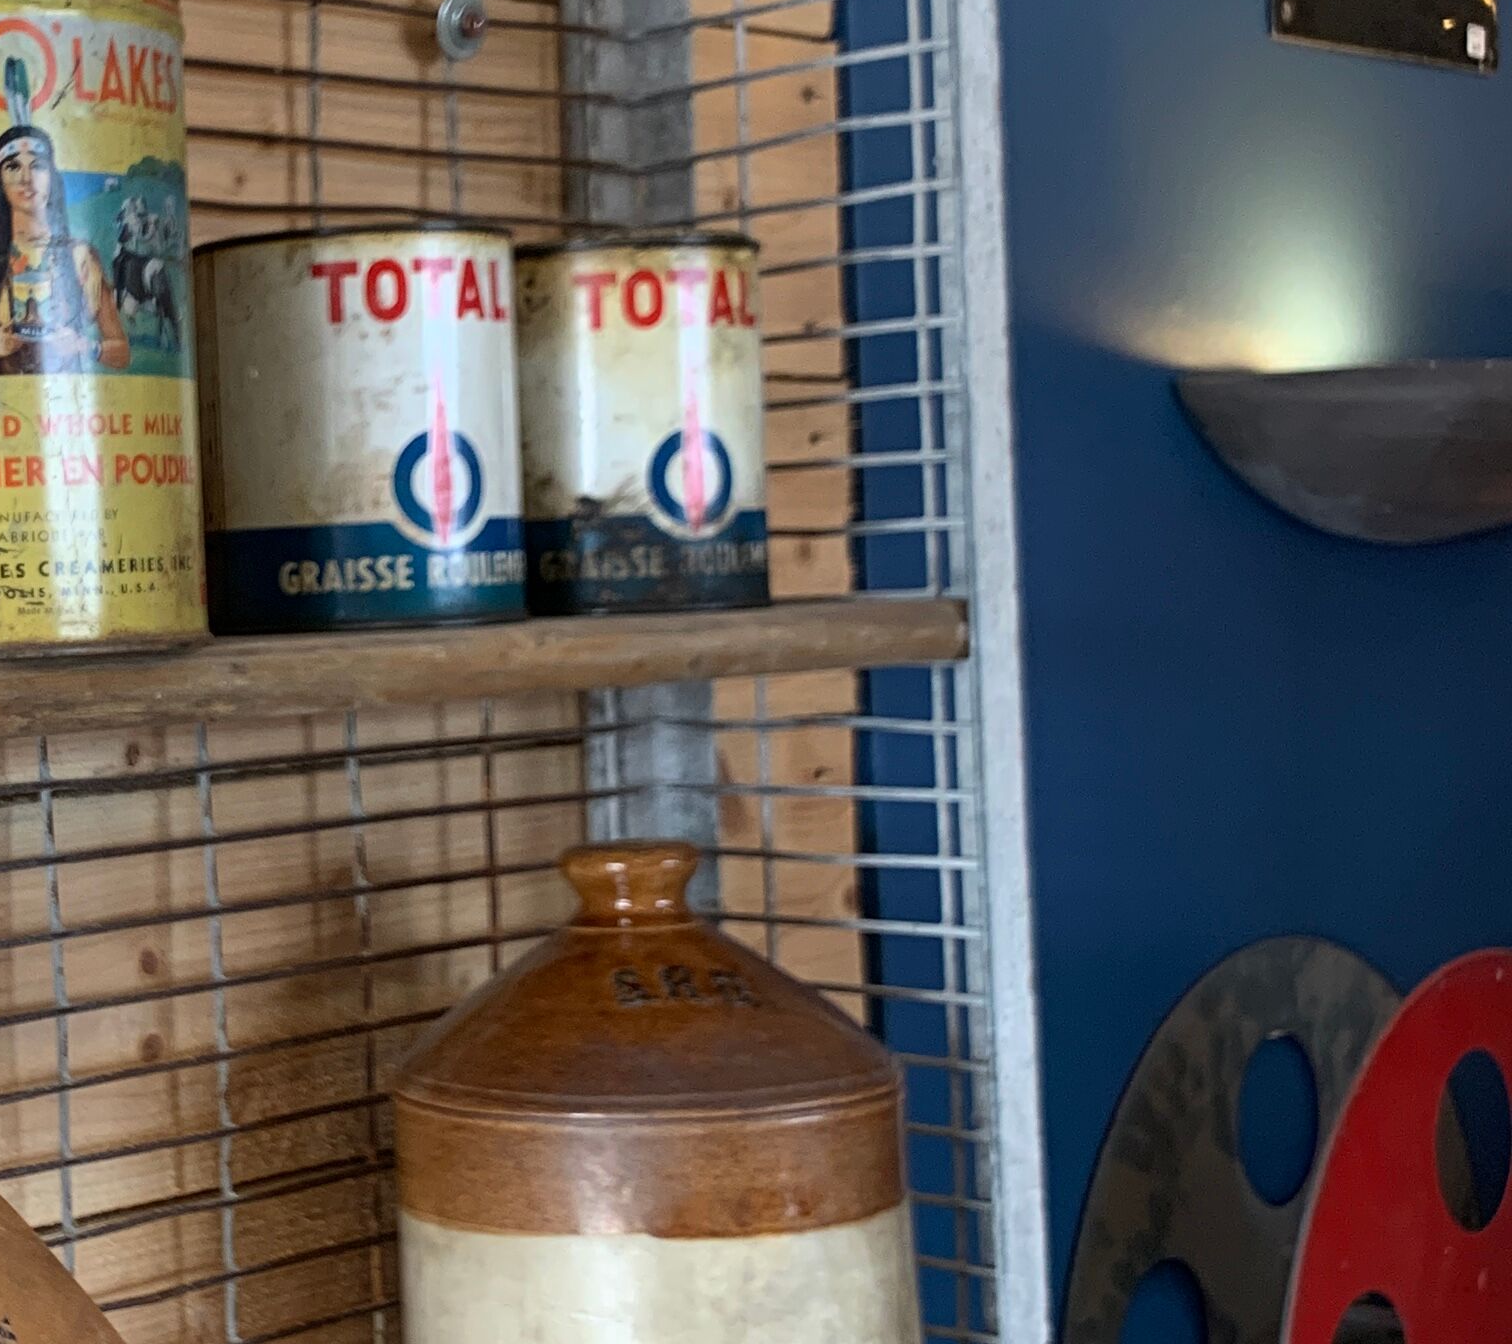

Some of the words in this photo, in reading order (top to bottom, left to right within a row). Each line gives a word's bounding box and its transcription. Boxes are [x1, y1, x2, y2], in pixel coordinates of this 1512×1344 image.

[310, 258, 507, 324] TOTAL
[573, 268, 757, 331] TOTAL
[37, 413, 133, 438] WHOLE
[143, 413, 183, 436] MILK
[60, 454, 104, 486] EN
[278, 554, 415, 595] GRAISSE
